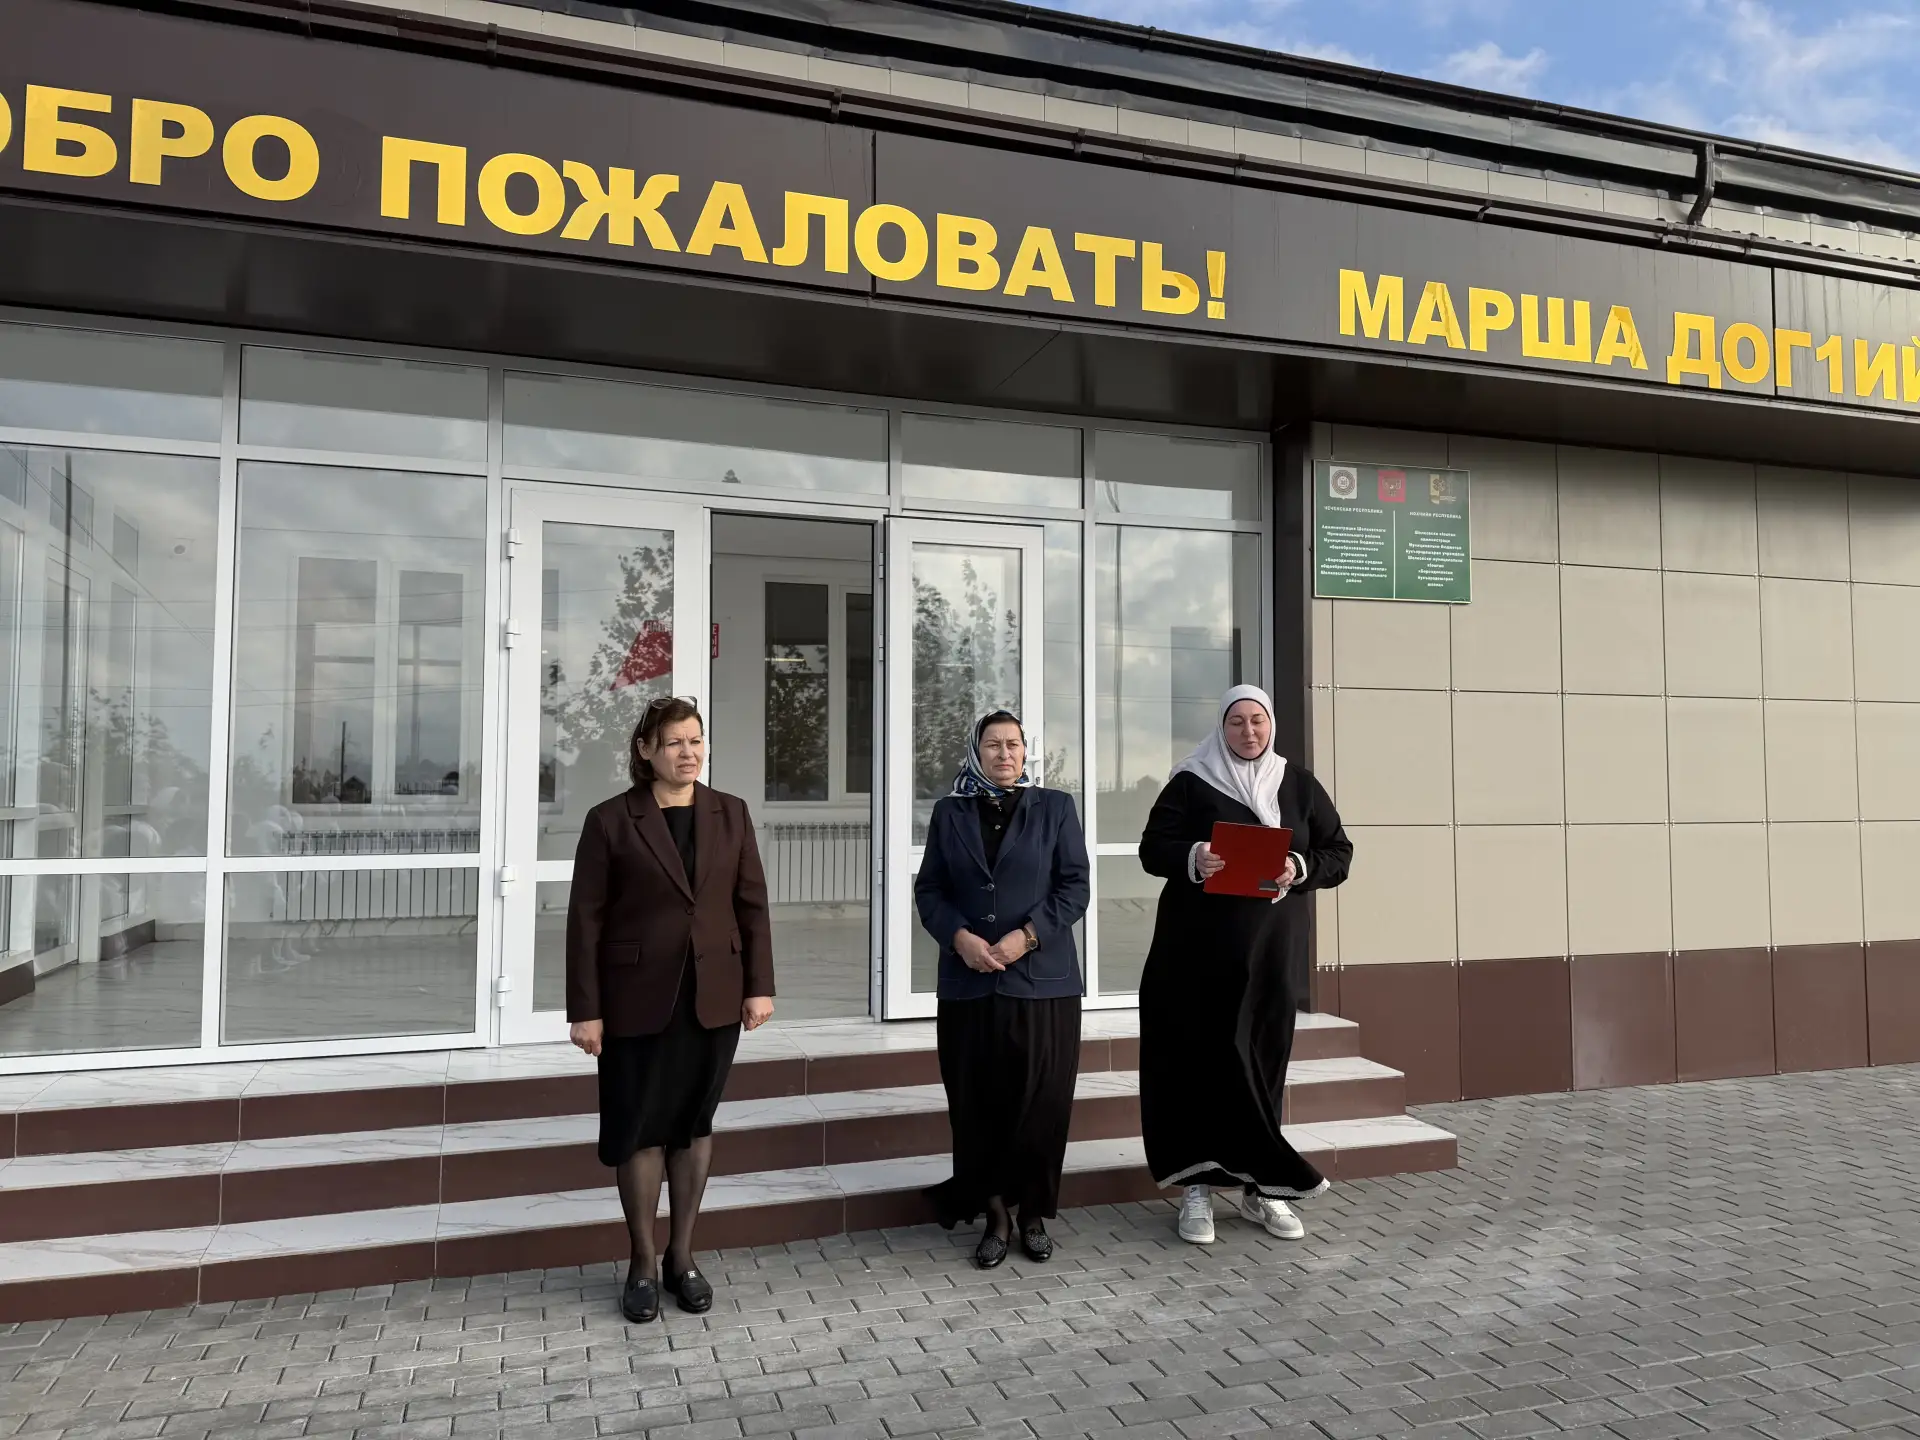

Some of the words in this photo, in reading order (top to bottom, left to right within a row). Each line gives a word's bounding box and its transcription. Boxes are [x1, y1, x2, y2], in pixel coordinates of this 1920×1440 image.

[0, 83, 319, 202] БРО
[380, 136, 1225, 319] ПОЖАЛОВАТЬ!
[1339, 268, 1648, 370] МАРША
